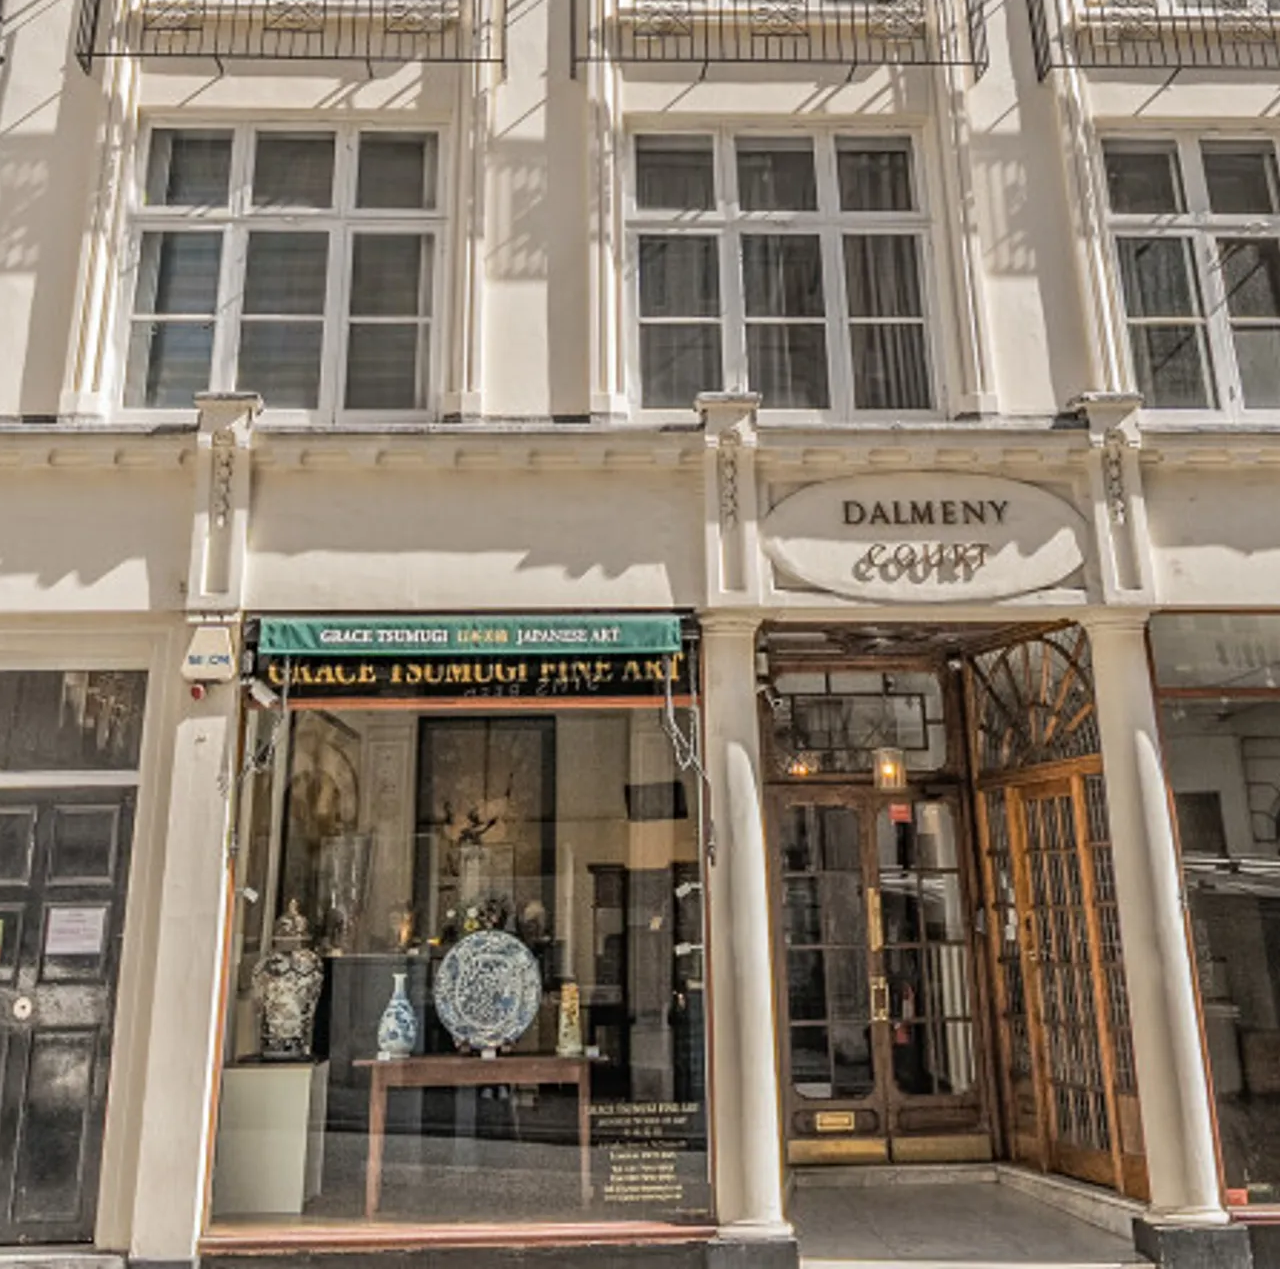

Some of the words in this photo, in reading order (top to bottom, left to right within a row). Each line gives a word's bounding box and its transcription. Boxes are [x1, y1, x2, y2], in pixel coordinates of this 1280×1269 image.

[842, 500, 1009, 525] DALMENY
[868, 542, 990, 569] COURT
[320, 629, 373, 643] GRACE
[377, 629, 448, 643] TSUMUGI
[516, 628, 587, 645] JAPANESE
[589, 628, 620, 642] ART
[267, 662, 377, 685] GRACE
[389, 661, 528, 683] TSUMUGI
